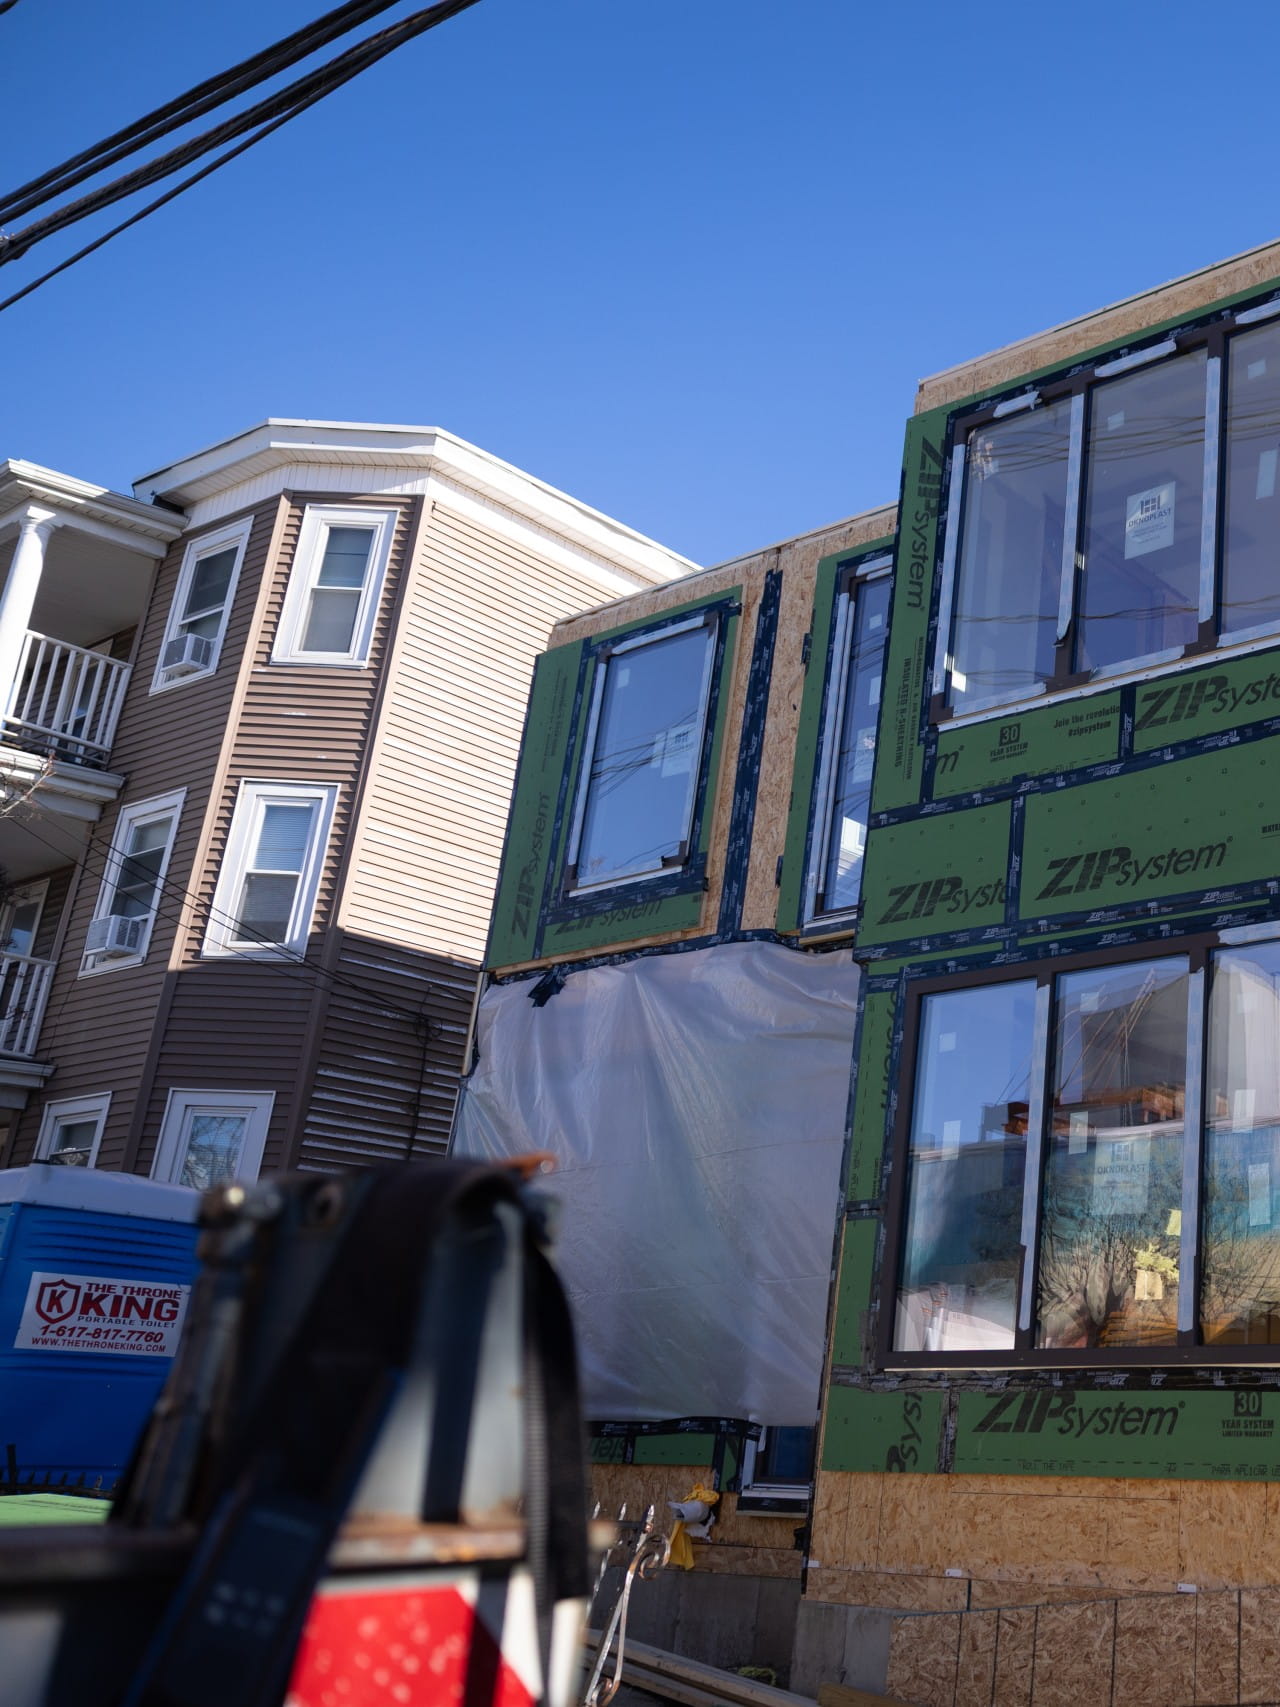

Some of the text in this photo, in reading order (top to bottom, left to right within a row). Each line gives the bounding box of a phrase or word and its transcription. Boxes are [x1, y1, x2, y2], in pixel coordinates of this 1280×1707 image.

[1054, 705, 1121, 729] Join the revolutio
[1001, 726, 1019, 744] 30
[1035, 841, 1226, 901] ZIPsystem
[86, 1282, 182, 1300] THE THRONE
[79, 1292, 180, 1322] KING
[77, 1315, 176, 1329] PORTABLE TOILET
[40, 1325, 163, 1344] 1-617-817-7760
[32, 1337, 166, 1353] WWW.THETHRONEKING.COM
[1237, 1391, 1259, 1414] 30
[972, 1391, 1180, 1438] ZIPsystem
[1243, 1419, 1275, 1429] SYSTEM
